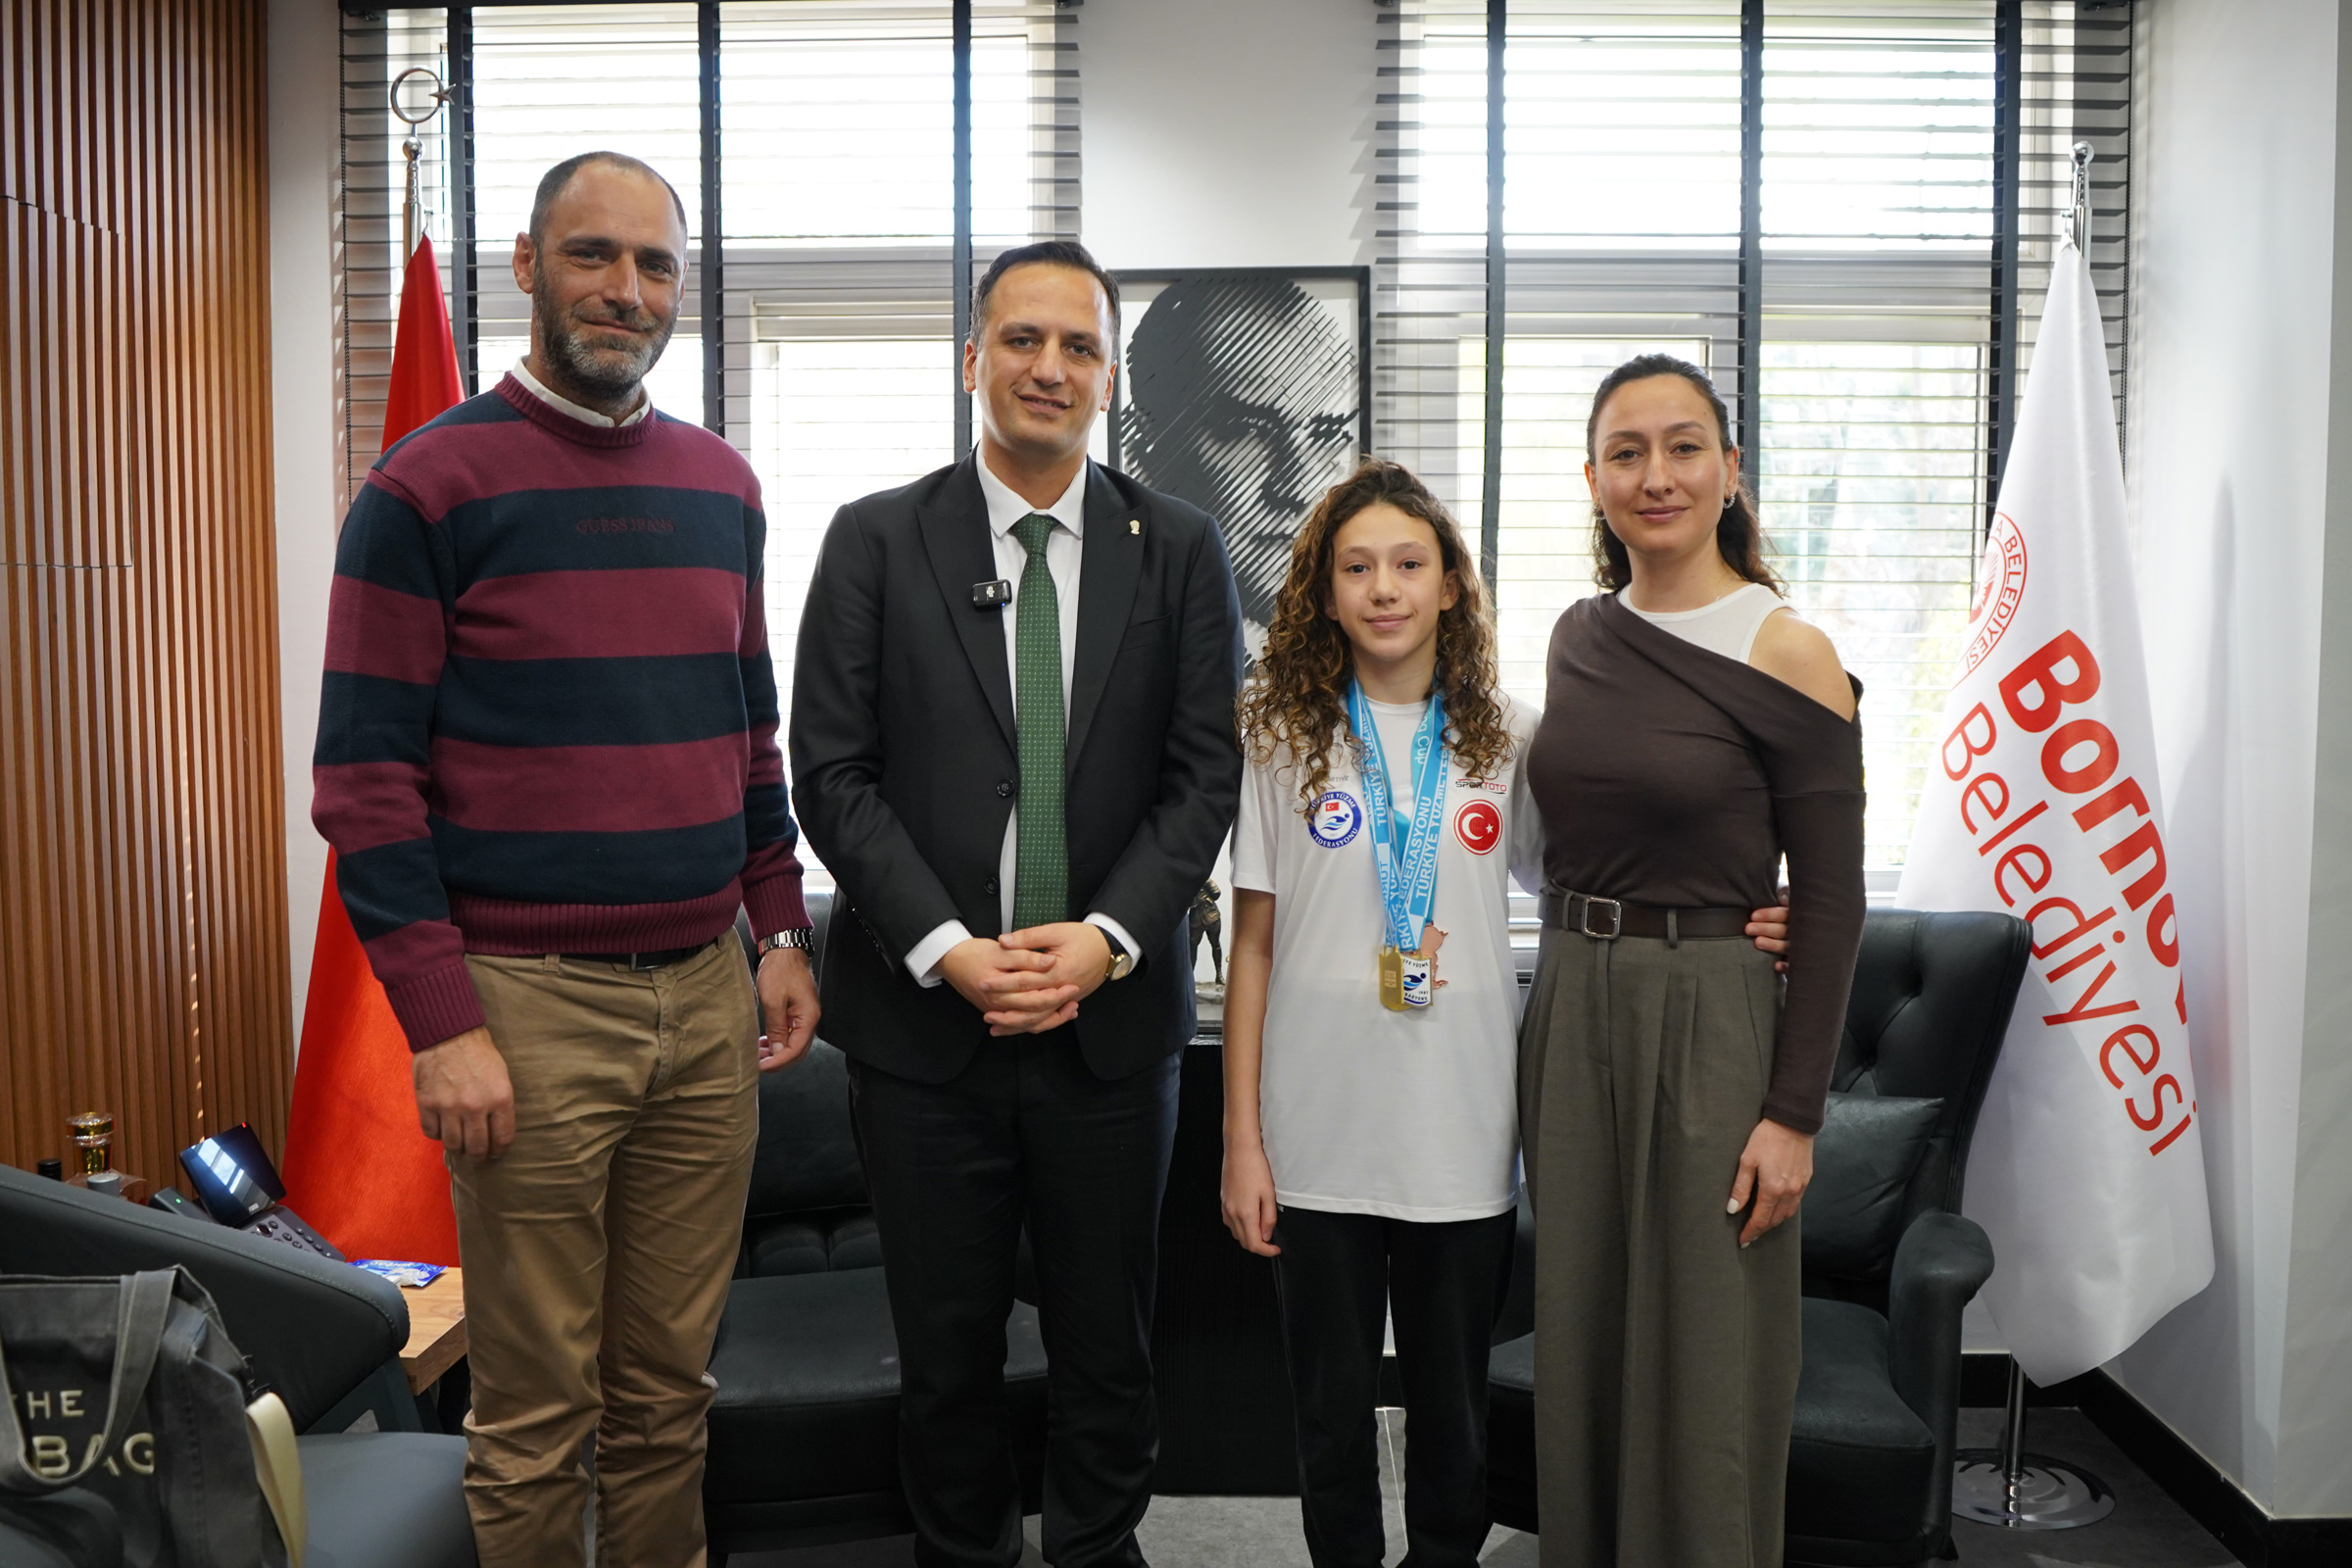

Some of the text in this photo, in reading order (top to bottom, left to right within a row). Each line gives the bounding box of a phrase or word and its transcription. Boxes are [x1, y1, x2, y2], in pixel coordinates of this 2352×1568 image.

[575, 518, 627, 534] GUESS
[1414, 735, 1431, 764] Cup
[1312, 827, 1358, 849] FEDERASYONU
[1941, 701, 2197, 1157] Belediyesi
[12, 1390, 85, 1420] HE
[32, 1432, 156, 1478] BAG
